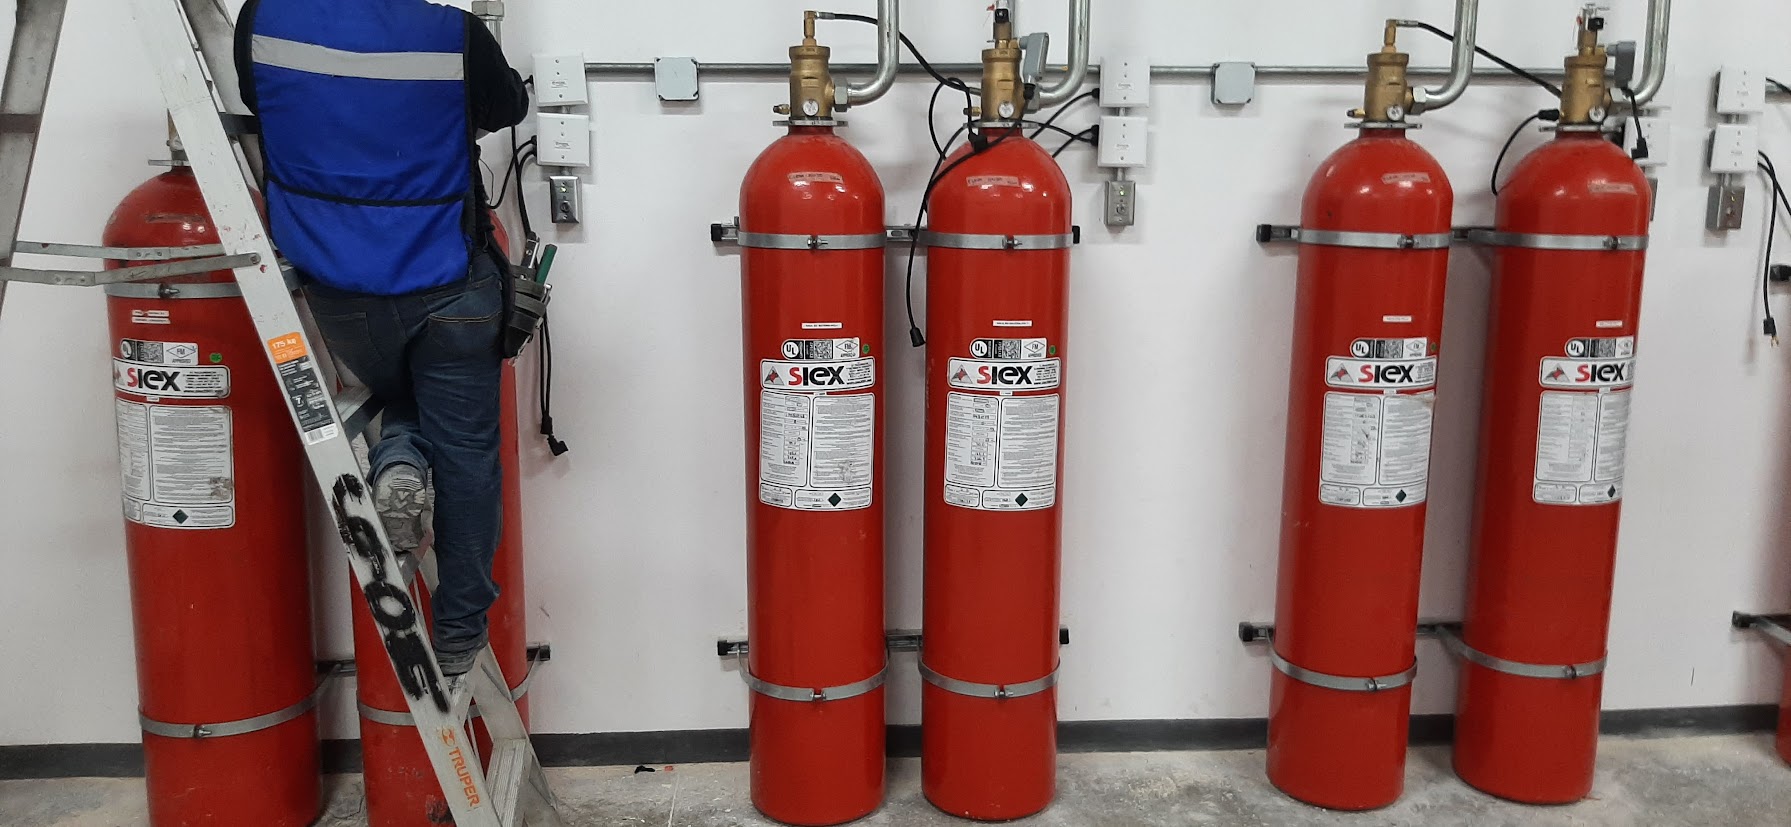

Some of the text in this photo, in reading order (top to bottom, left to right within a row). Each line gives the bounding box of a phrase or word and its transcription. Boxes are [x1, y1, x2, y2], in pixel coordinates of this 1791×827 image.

[786, 344, 796, 355] UL
[975, 344, 985, 354] UL
[1355, 344, 1366, 354] UL
[449, 746, 480, 808] TRUPER
